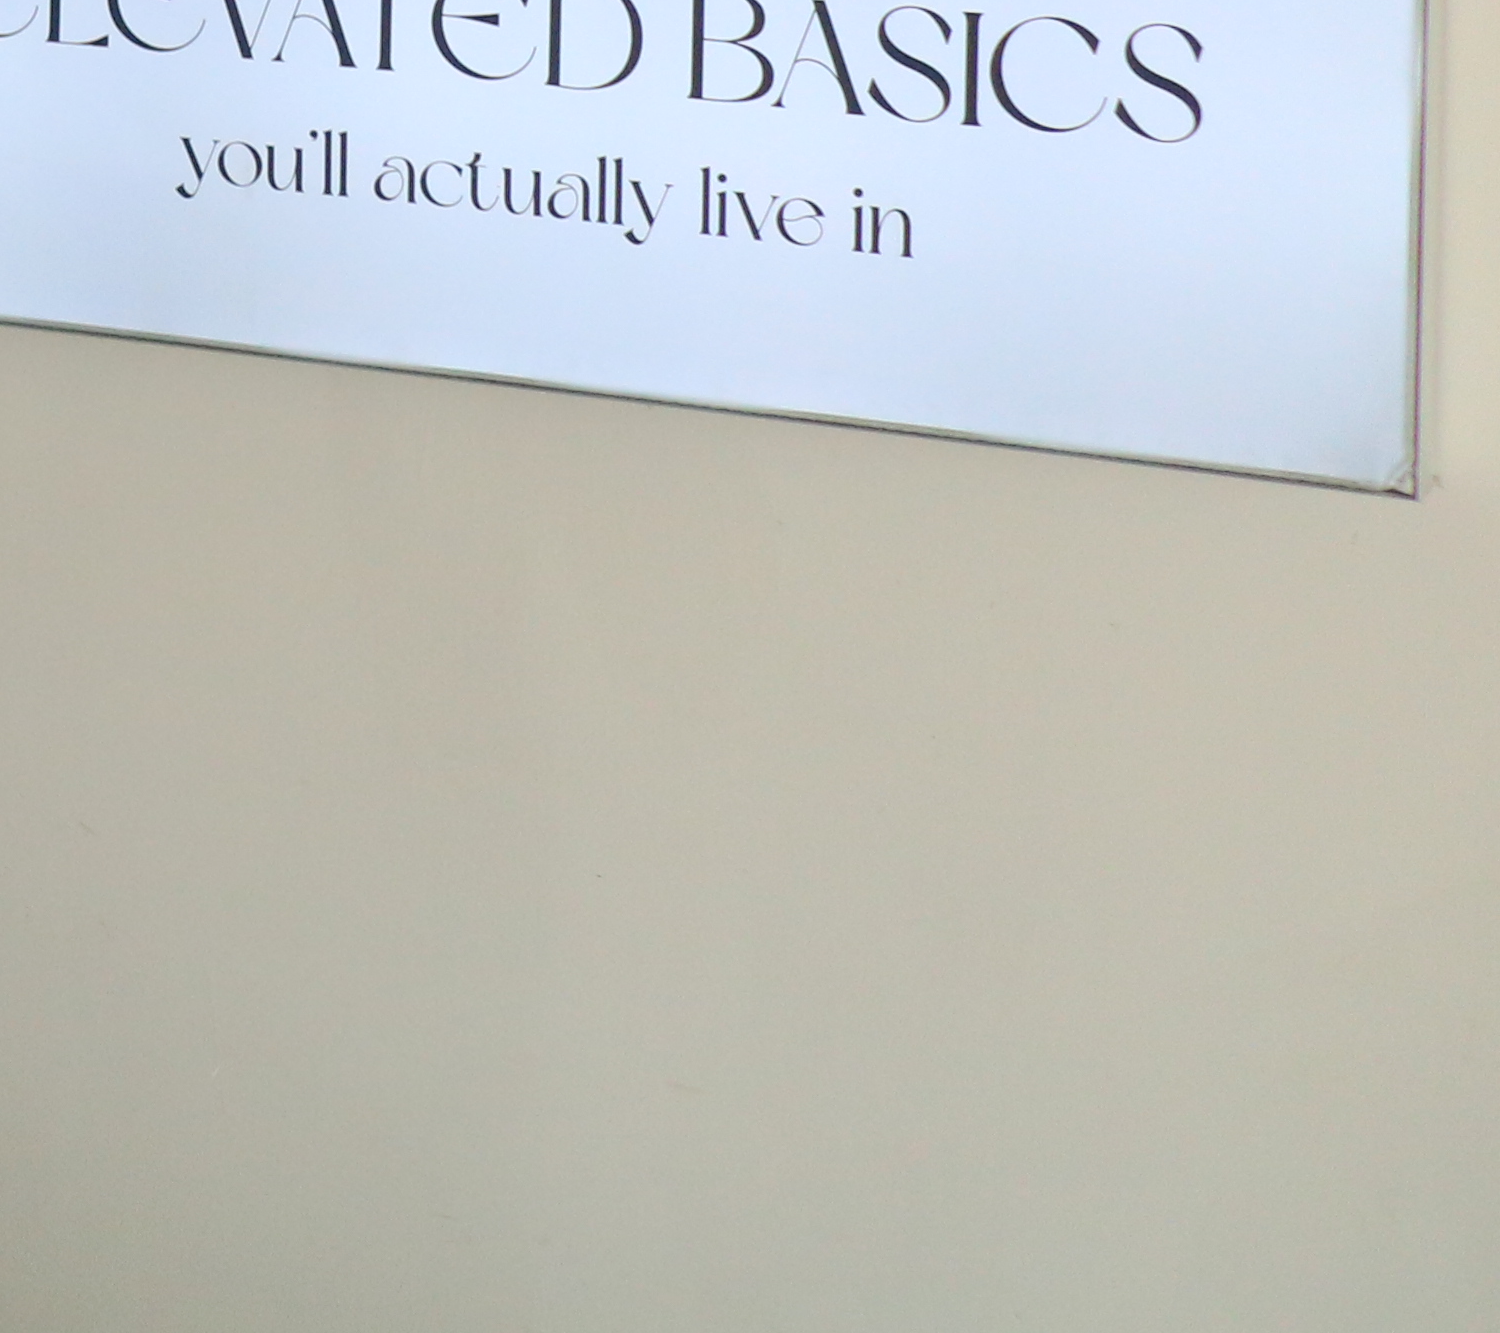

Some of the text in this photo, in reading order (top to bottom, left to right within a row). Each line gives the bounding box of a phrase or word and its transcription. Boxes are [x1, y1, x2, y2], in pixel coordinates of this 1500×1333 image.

[174, 128, 915, 260] you'll actually live in
